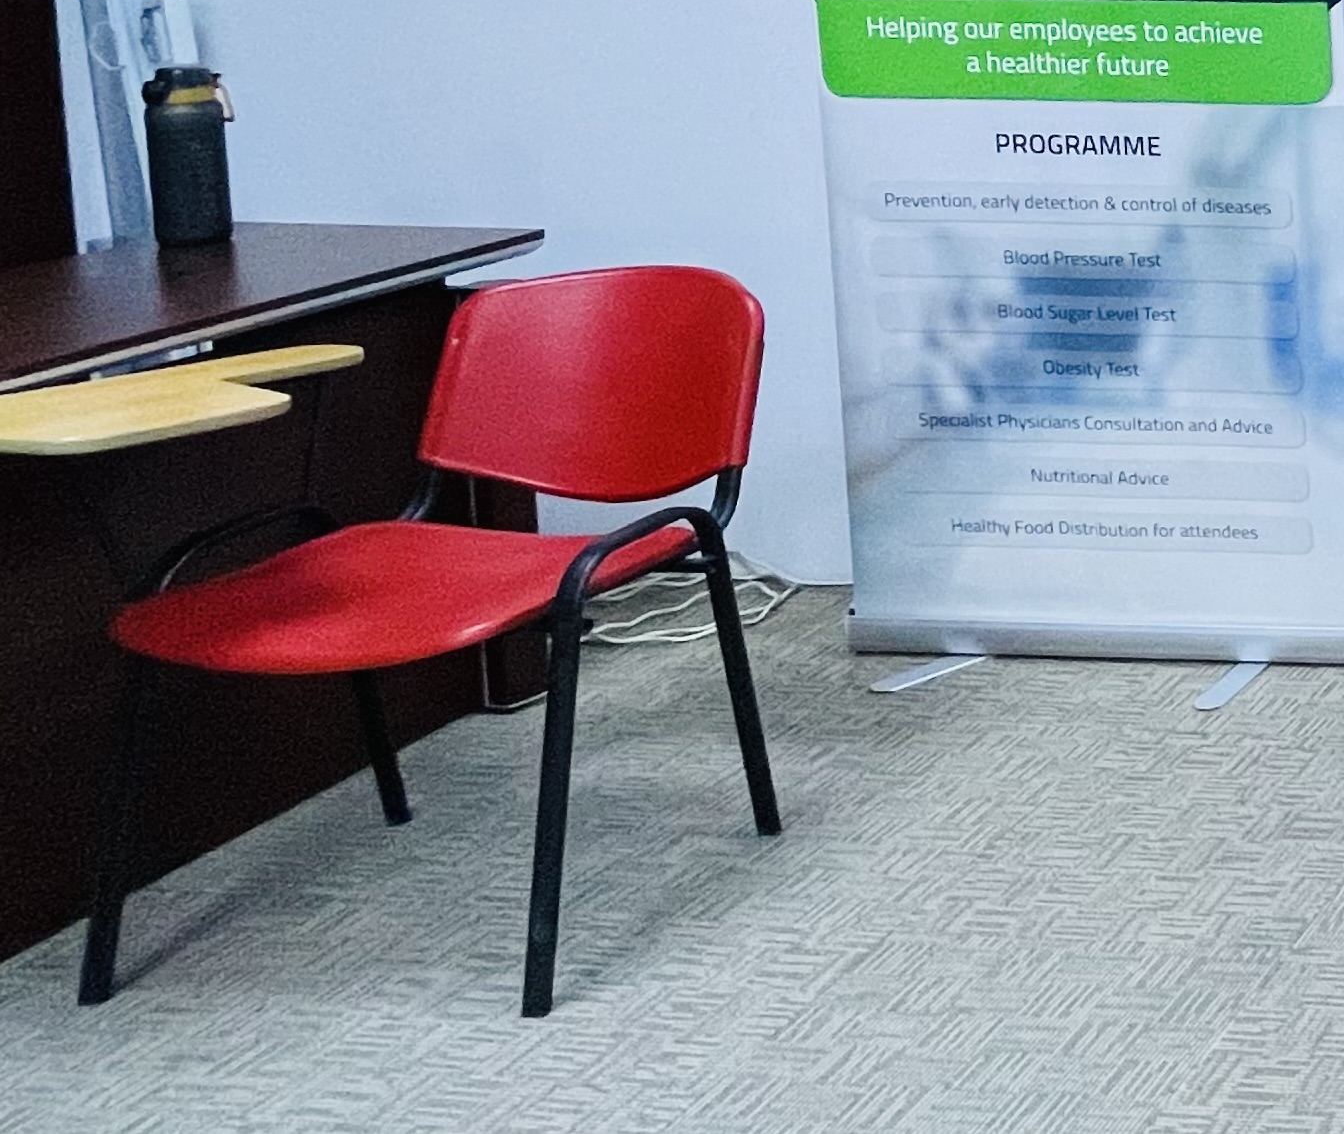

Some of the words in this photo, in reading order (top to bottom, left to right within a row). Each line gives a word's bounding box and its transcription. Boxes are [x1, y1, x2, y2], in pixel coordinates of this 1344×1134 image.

[866, 16, 957, 45] Helping
[964, 21, 1001, 39] our
[1010, 19, 1136, 47] employees
[1144, 22, 1169, 43] to
[1175, 21, 1263, 45] achieve
[967, 56, 981, 73] a
[987, 53, 1090, 75] healthier
[1097, 53, 1170, 77] future
[995, 132, 1162, 157] PROGRAMME
[884, 192, 977, 210] Prevention,
[981, 192, 1020, 214] early
[1024, 195, 1099, 212] detection
[1104, 196, 1116, 211] &
[1121, 197, 1177, 213] control
[1181, 197, 1197, 214] of
[1202, 198, 1272, 216] diseases
[1004, 250, 1050, 266] Blood
[1053, 251, 1124, 268] Pressure
[1129, 252, 1161, 269] Test
[997, 304, 1043, 320] Blood
[1047, 305, 1094, 325] Sugar
[1097, 306, 1138, 322] Level
[1143, 307, 1177, 323] Test
[1042, 360, 1102, 380] Obesity
[1106, 361, 1140, 377] Test
[918, 412, 993, 432] Specialist
[997, 414, 1080, 434] Physicians
[1084, 415, 1184, 433] Consultation
[1188, 418, 1218, 434] and
[1222, 418, 1273, 436] Advice
[1030, 469, 1113, 486] Nutritional
[1118, 470, 1170, 487] Advice
[951, 518, 1011, 538] Healthy
[1014, 520, 1054, 536] Food
[1058, 521, 1148, 538] Distribution
[1153, 522, 1175, 539] for
[1179, 523, 1259, 541] attendees
